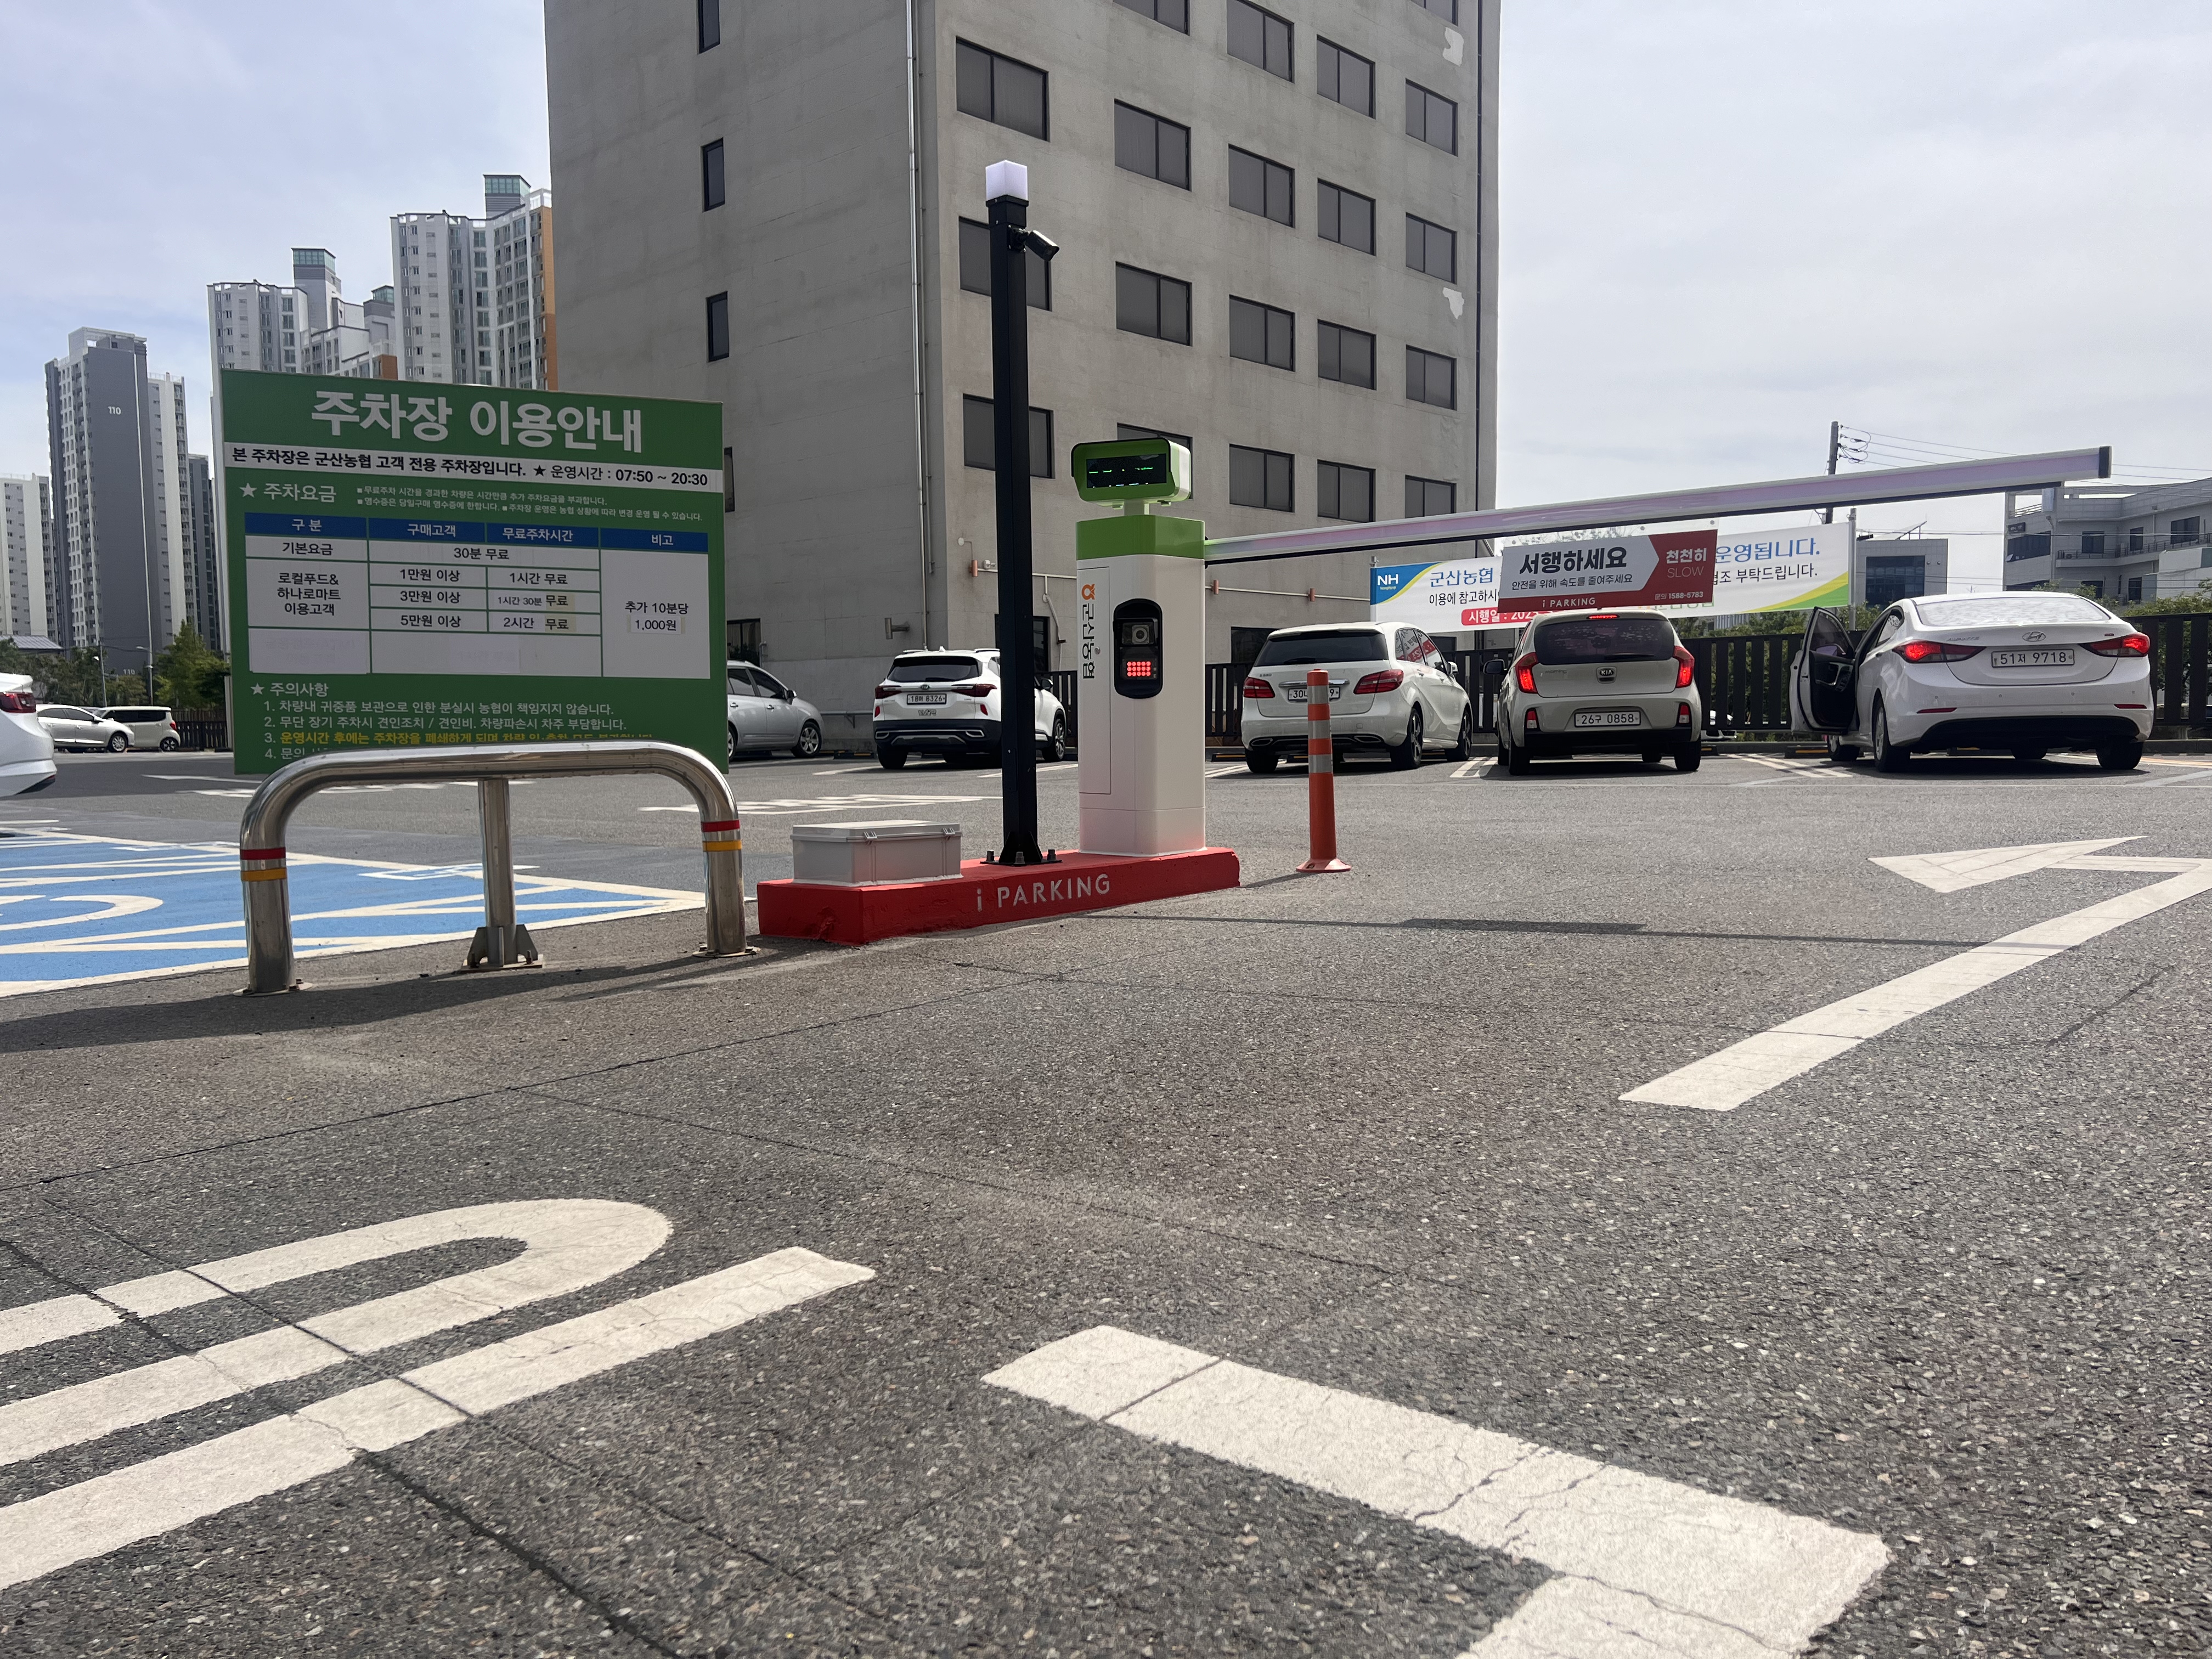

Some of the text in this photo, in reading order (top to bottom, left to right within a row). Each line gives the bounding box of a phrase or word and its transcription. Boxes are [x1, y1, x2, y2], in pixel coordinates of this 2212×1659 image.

[108, 406, 121, 415] 110
[312, 391, 641, 453] 주차장 이용안내
[233, 448, 247, 462] 본
[252, 449, 310, 466] 주차장은
[315, 452, 371, 469] 군산농협
[376, 456, 404, 470] 고객
[409, 458, 437, 472] 전용
[441, 460, 526, 476] 주차장입니다.
[550, 465, 603, 481] 운영시간
[616, 469, 653, 483] 07:50
[672, 472, 708, 486] 20:30
[263, 483, 337, 503] 주차요금
[364, 486, 396, 495] 무료주차
[399, 487, 422, 496] 시간을
[425, 488, 448, 498] 경과한
[451, 489, 474, 499] 차량은
[510, 492, 525, 501] 추가
[527, 494, 565, 503] 주차요금을
[509, 504, 532, 513] 주차장
[534, 505, 557, 514] 운영은
[560, 506, 574, 515] 농협
[577, 507, 599, 516] 상황에
[601, 508, 616, 517] 따라
[619, 509, 633, 517] 변경
[635, 510, 650, 518] 운영
[662, 511, 669, 520] 수
[672, 512, 703, 521] 있습니다.
[408, 523, 456, 538] 구매고객
[502, 527, 573, 543] 무료주차시간
[652, 534, 674, 546] 비고
[282, 543, 510, 560] 기본요금 30분 무료
[1666, 548, 1707, 565] 천천히
[1430, 538, 1820, 587] 군산농협 운영됩니다.
[1520, 546, 1627, 574] 서행하세요
[278, 572, 338, 586] 로컬푸드&
[400, 568, 568, 585] 1만원 이상 1시간 무료
[1378, 573, 1398, 585] NH
[1667, 566, 1704, 578] SLOW
[1429, 592, 1455, 606] 이용에
[1736, 563, 1818, 583] 부탁드립니다.
[1512, 573, 1633, 590] 안전을 위해 속도를 줄여주세요
[276, 588, 341, 601] 하나로마트
[400, 590, 568, 606] 3만원 이상 1시간 30분 무료
[1550, 597, 1596, 607] PARKING
[285, 603, 335, 617] 이용고객
[624, 602, 689, 615] 추가 10분당
[400, 614, 569, 630] 5만원 이상 2시간 무료
[1469, 610, 1500, 623] 시행일
[635, 619, 676, 631] 1,000원
[1082, 602, 1094, 679] 군산농협
[2000, 652, 2067, 664] 51저 9718
[270, 682, 329, 697] 주의사항
[264, 701, 614, 715] 1. 차량내 귀중품 보관으로 인한 분실시 농협이 책임지지 않습니다.
[264, 716, 627, 730] 2. 무단 장기 주차시 견인조치 / 견인비. 차량파손시 차주 부담합니다.
[1581, 714, 1634, 724] 26구 0858
[264, 732, 276, 743] 3.
[280, 732, 329, 744] 운영시간
[333, 732, 369, 744] 후에는
[374, 732, 421, 744] 주차장을
[425, 732, 471, 744] 폐쇄하게
[476, 733, 499, 742] 되며
[264, 748, 276, 759] 4.
[281, 748, 305, 760] 문의
[977, 873, 1110, 912] i PARKING
